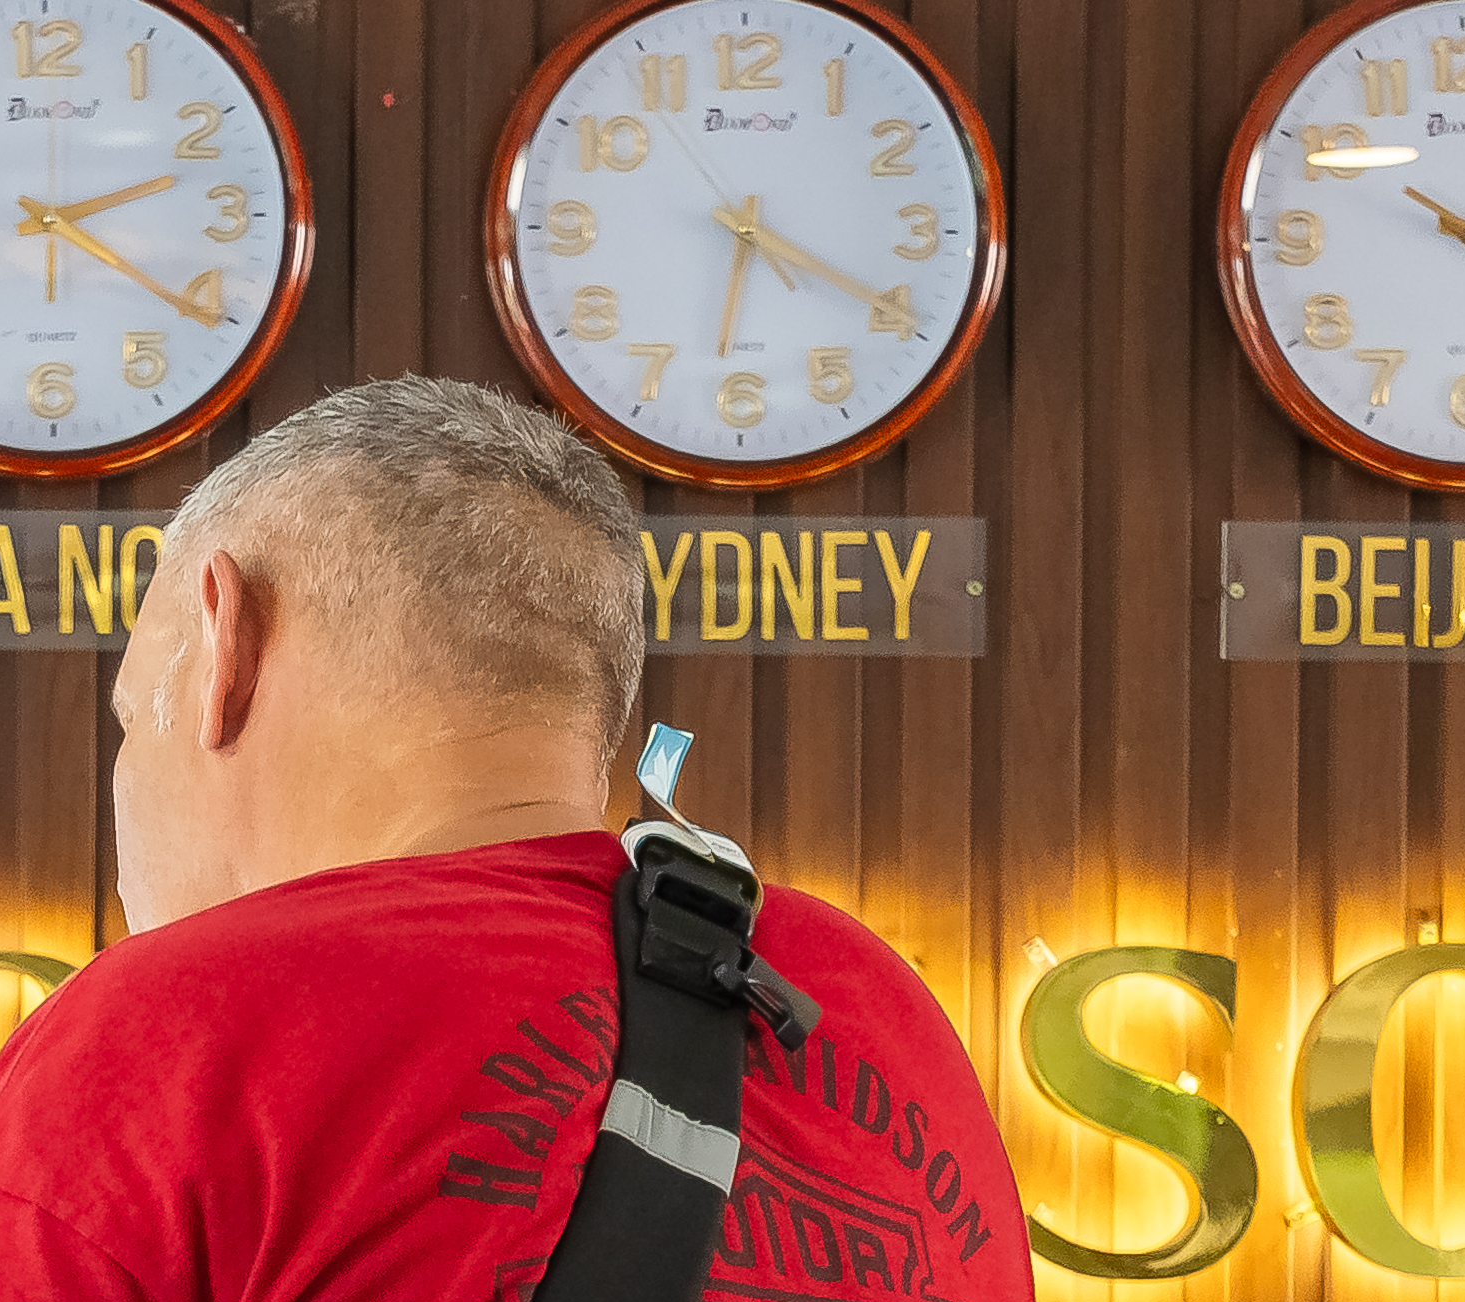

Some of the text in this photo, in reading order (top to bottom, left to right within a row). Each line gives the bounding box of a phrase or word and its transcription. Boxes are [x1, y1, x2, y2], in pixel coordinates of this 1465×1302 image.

[11, 20, 81, 78] 12
[126, 43, 149, 100] 1
[713, 33, 782, 90] 12
[640, 55, 686, 112] 11
[824, 58, 844, 116] 1
[1361, 59, 1407, 116] 11
[175, 102, 220, 159] 2
[577, 115, 648, 172] 10
[870, 119, 916, 177] 2
[1301, 123, 1369, 180] 10
[203, 184, 249, 242] 3
[547, 201, 596, 257] 9
[894, 203, 939, 261] 3
[1276, 210, 1324, 266] 9
[179, 269, 227, 328] 4
[571, 285, 618, 341] 8
[869, 285, 918, 341] 4
[1304, 294, 1353, 350] 8
[122, 331, 167, 389] 5
[627, 345, 676, 401] 7
[808, 348, 853, 404] 5
[1354, 349, 1406, 406] 7
[27, 362, 75, 420] 6
[717, 372, 764, 428] 6
[58, 524, 164, 635] NO
[639, 530, 932, 641] YDNEY
[438, 986, 993, 1263] HARLE AVIDSON
[718, 1174, 895, 1293] OTOR
